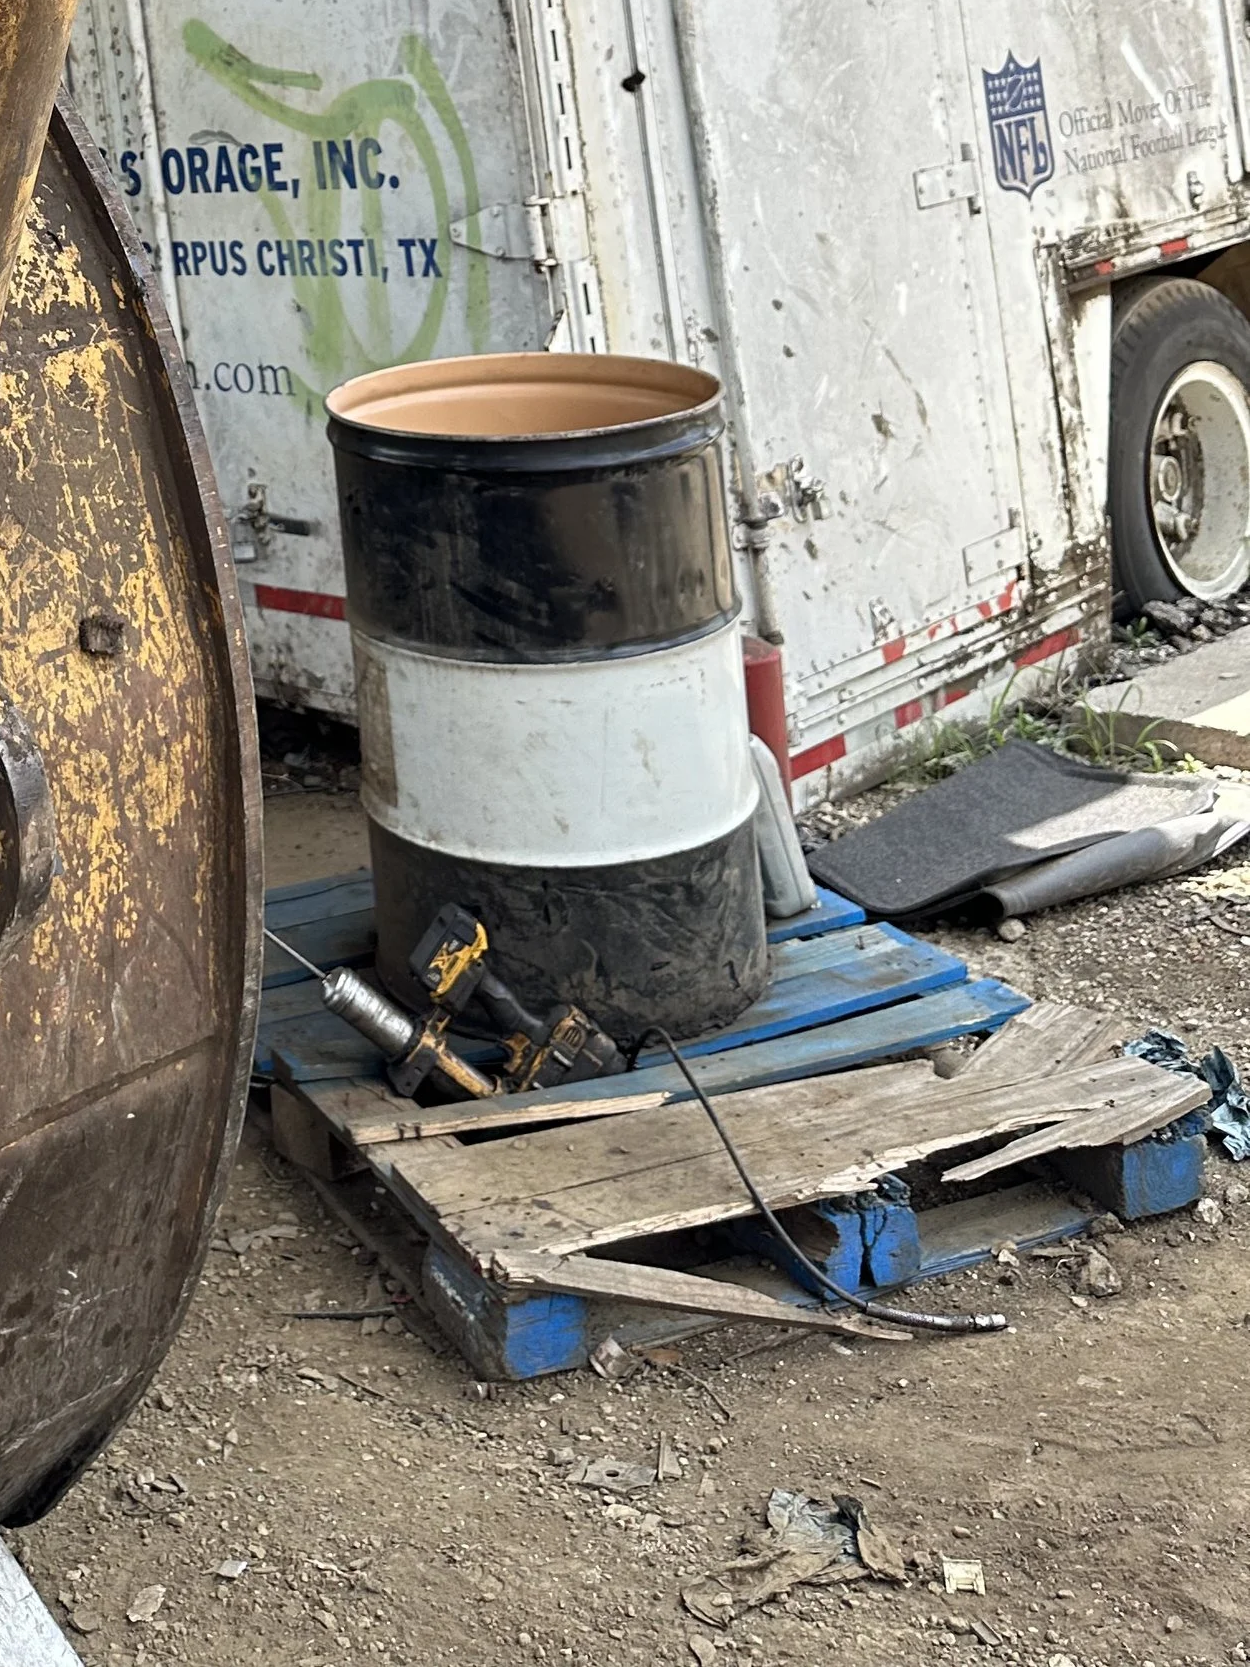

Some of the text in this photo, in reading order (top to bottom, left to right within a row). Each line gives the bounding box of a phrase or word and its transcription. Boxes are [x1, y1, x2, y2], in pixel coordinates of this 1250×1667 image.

[120, 142, 300, 199] SORAGE,
[312, 137, 400, 190] INC.
[994, 116, 1049, 187] NFL
[1063, 134, 1128, 175] National
[1130, 124, 1183, 161] Football
[142, 238, 443, 283] RPUS CHRISTI, TX
